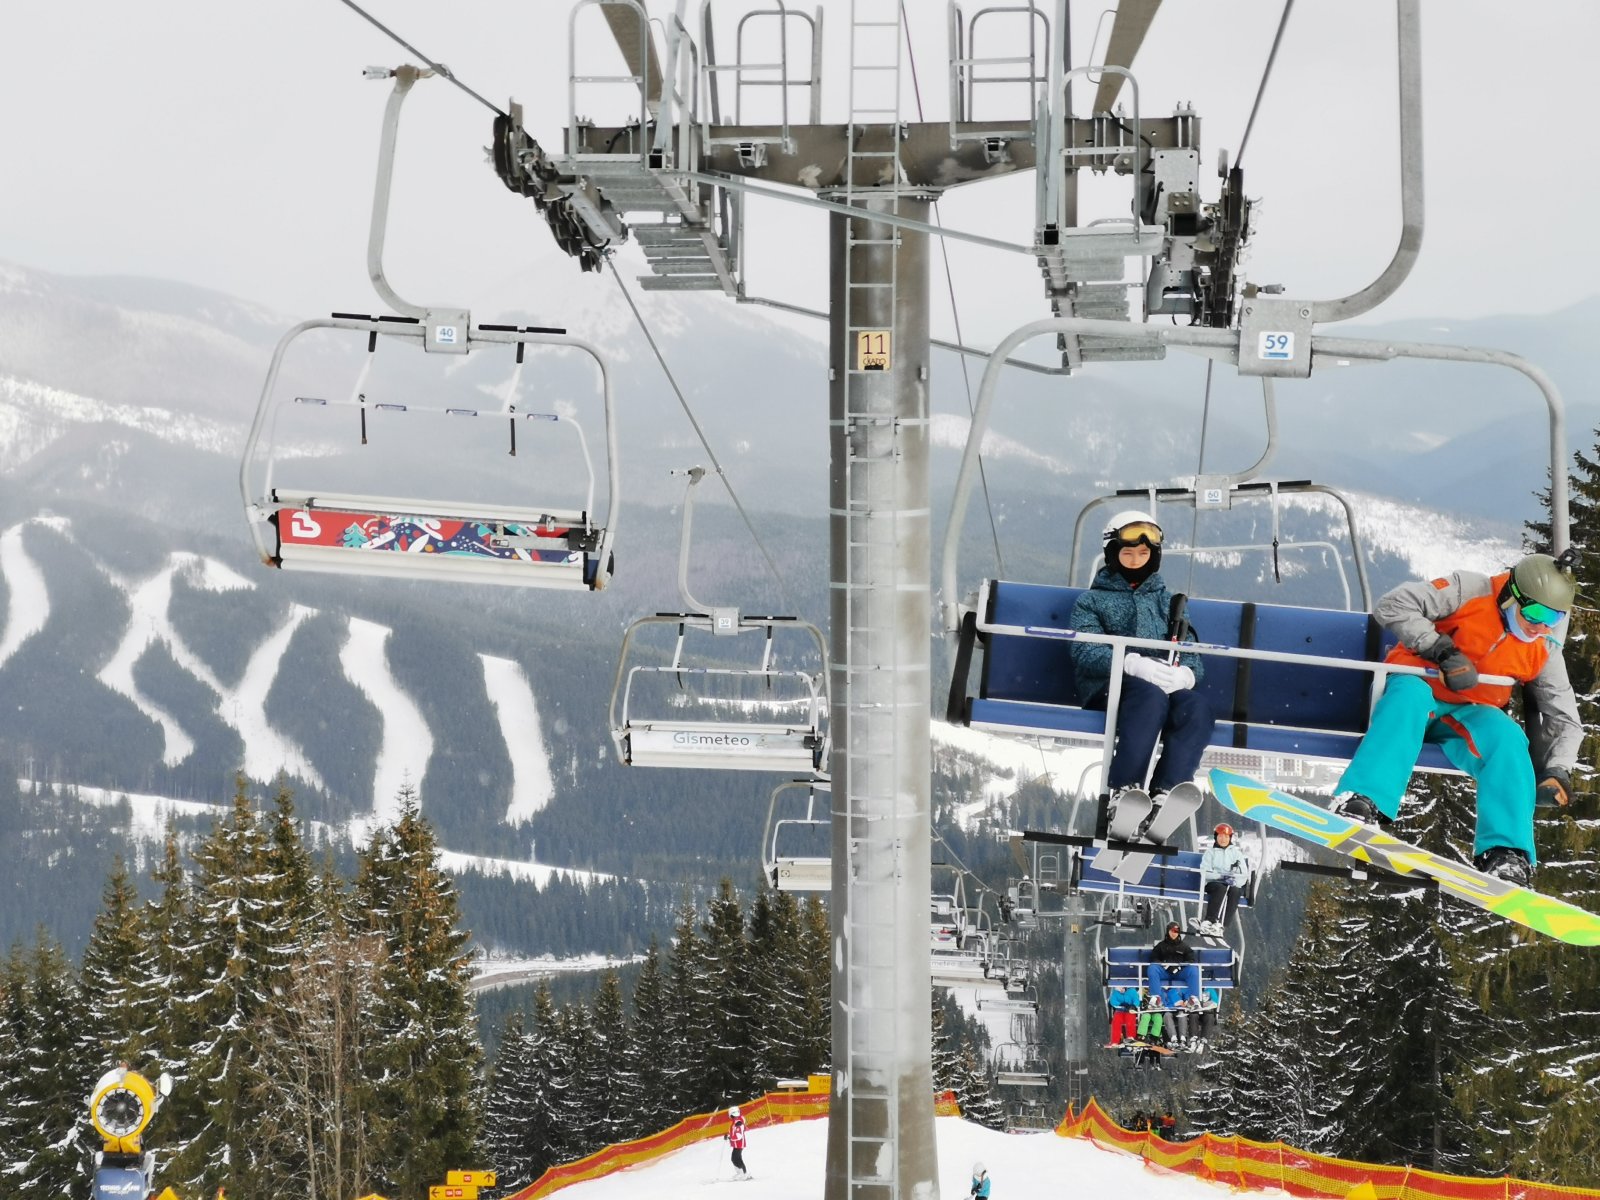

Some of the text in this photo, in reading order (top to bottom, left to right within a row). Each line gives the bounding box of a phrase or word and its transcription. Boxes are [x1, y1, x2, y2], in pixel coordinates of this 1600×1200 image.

[439, 327, 454, 338] 40
[862, 334, 886, 354] 11
[1264, 334, 1289, 350] 59
[673, 731, 750, 746] Gismeteo
